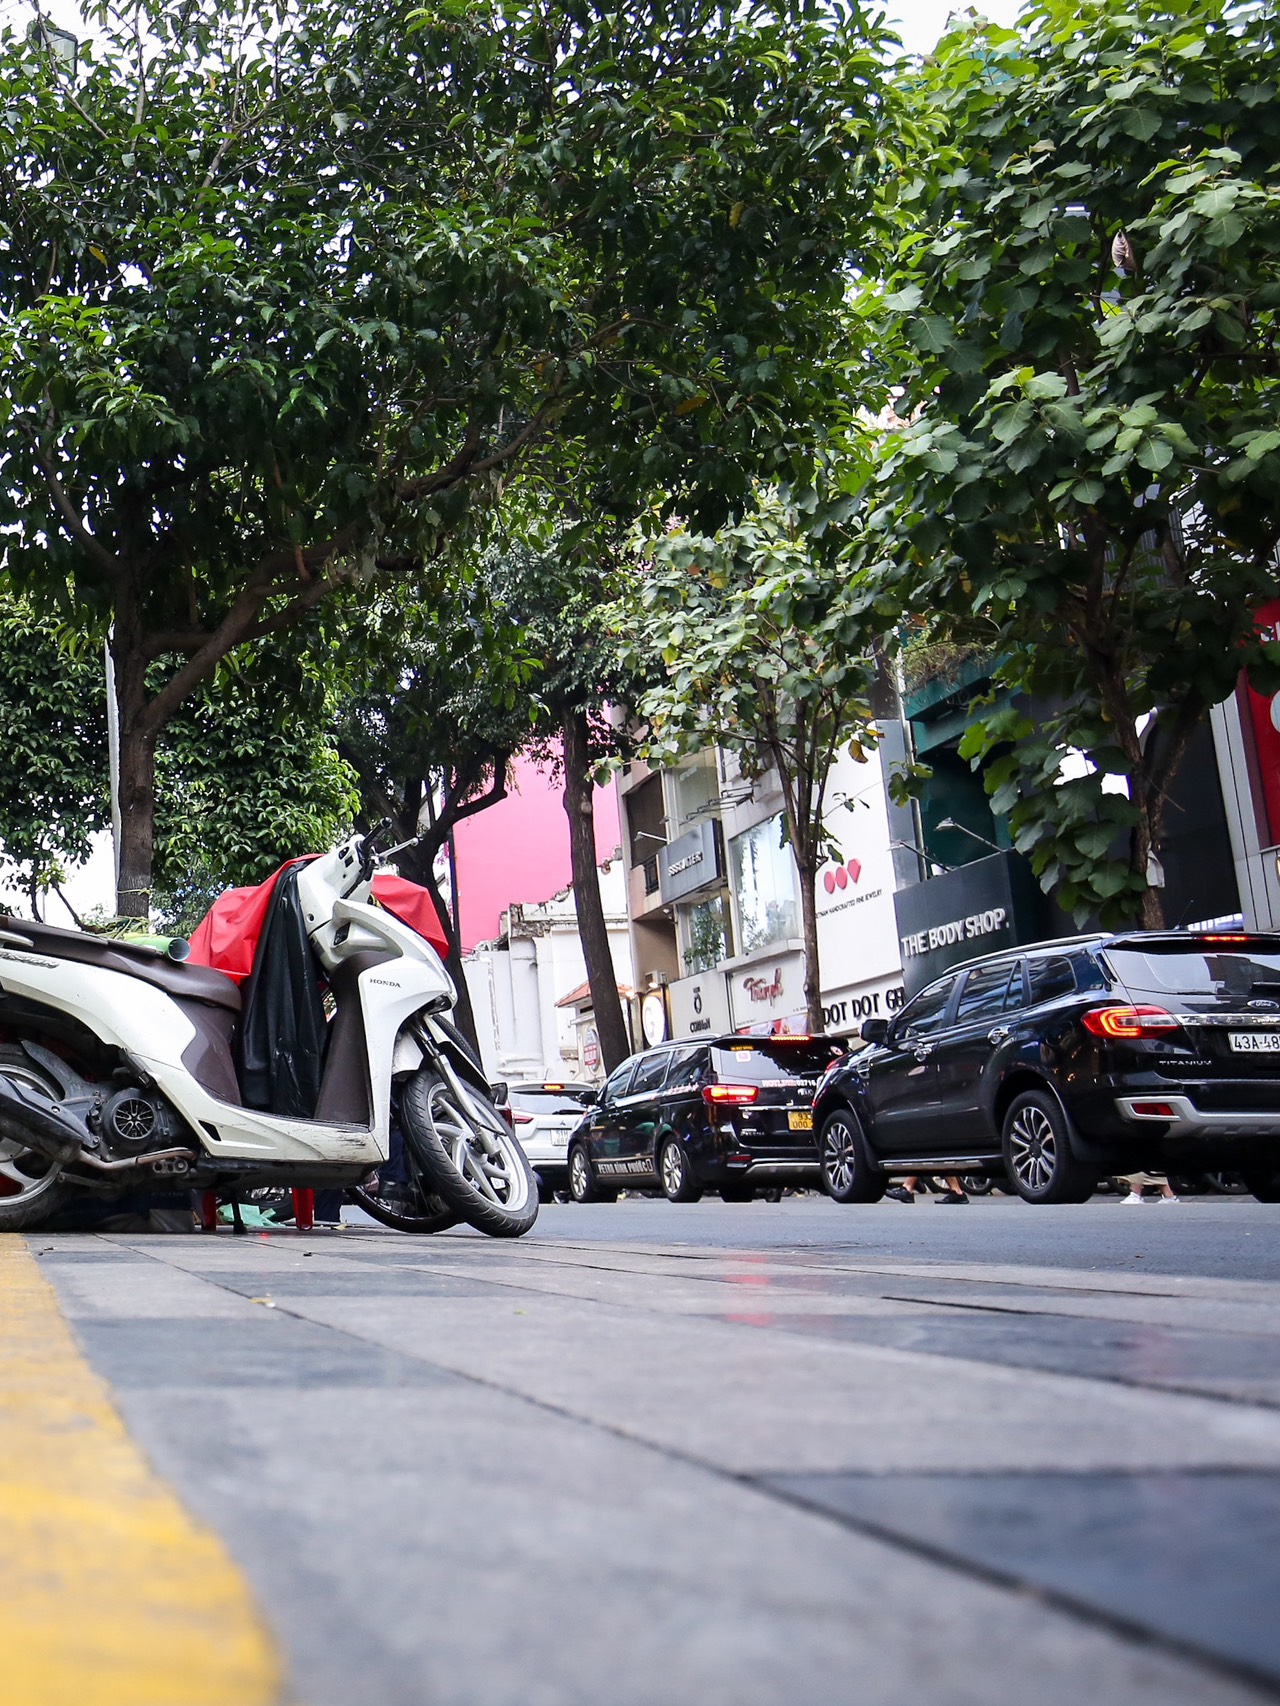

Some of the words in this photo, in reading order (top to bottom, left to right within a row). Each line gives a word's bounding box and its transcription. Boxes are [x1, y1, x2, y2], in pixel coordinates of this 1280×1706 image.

[900, 930, 929, 957] THE
[928, 919, 965, 950] BODY
[369, 978, 402, 988] HONDA
[852, 993, 879, 1018] DOT
[1234, 1035, 1280, 1050] 43A-48
